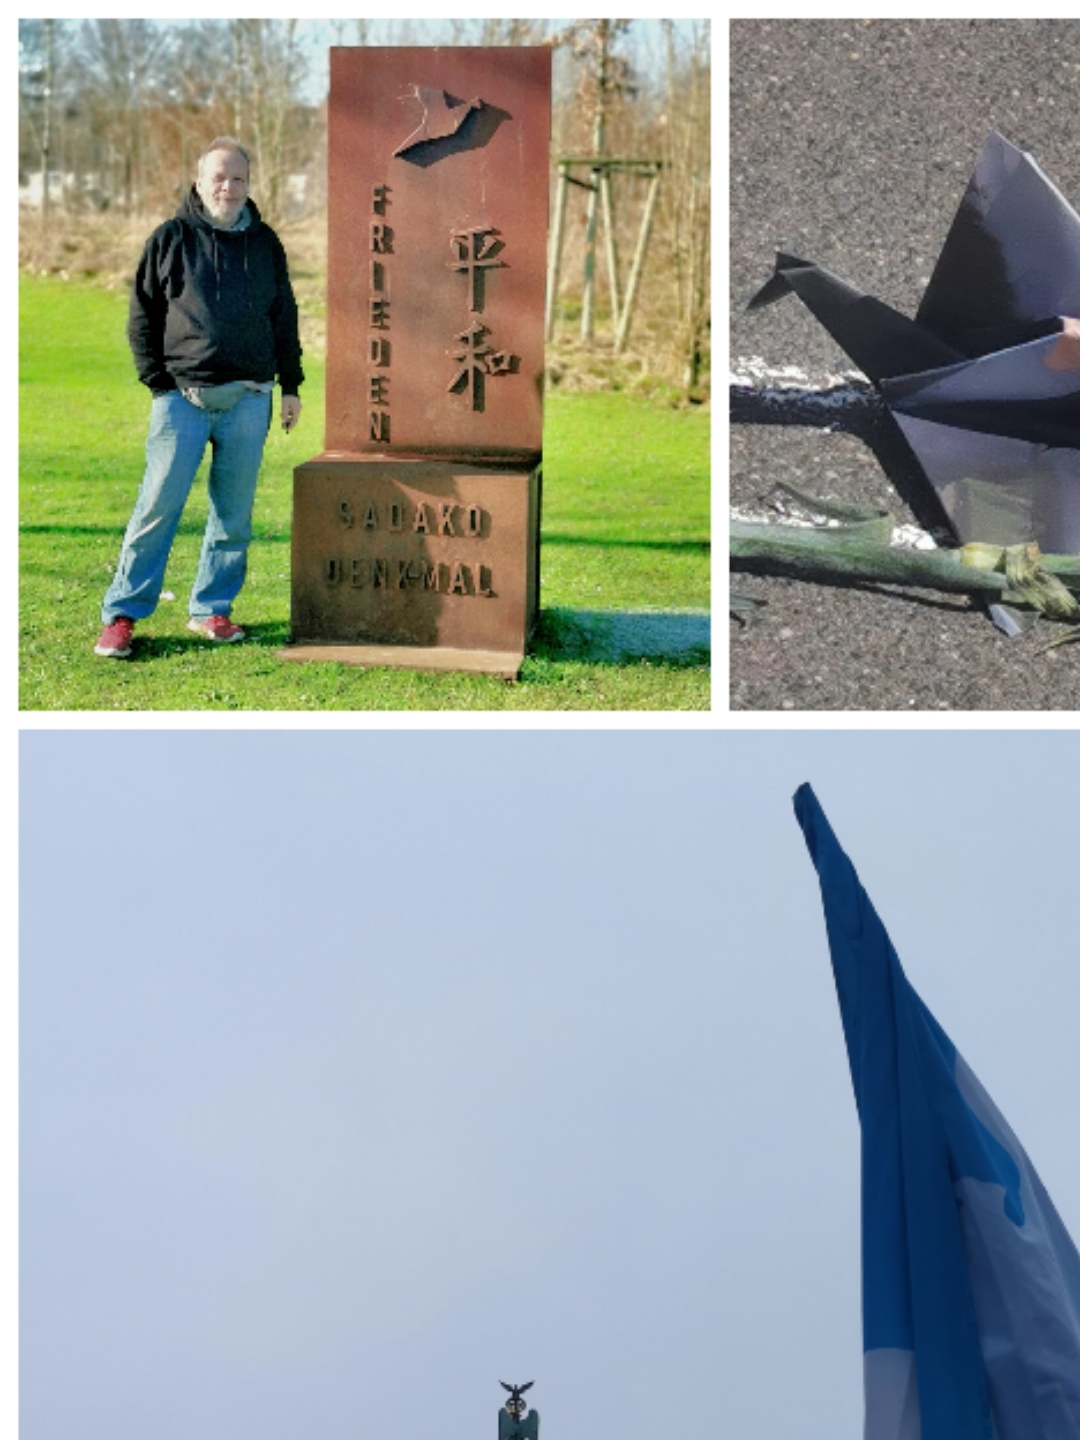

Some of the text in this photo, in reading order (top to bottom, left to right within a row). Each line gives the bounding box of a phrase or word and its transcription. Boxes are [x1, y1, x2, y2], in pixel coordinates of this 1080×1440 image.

[369, 184, 395, 444] FRIEDEN
[445, 226, 521, 413] 平和
[336, 499, 493, 538] SADAKO
